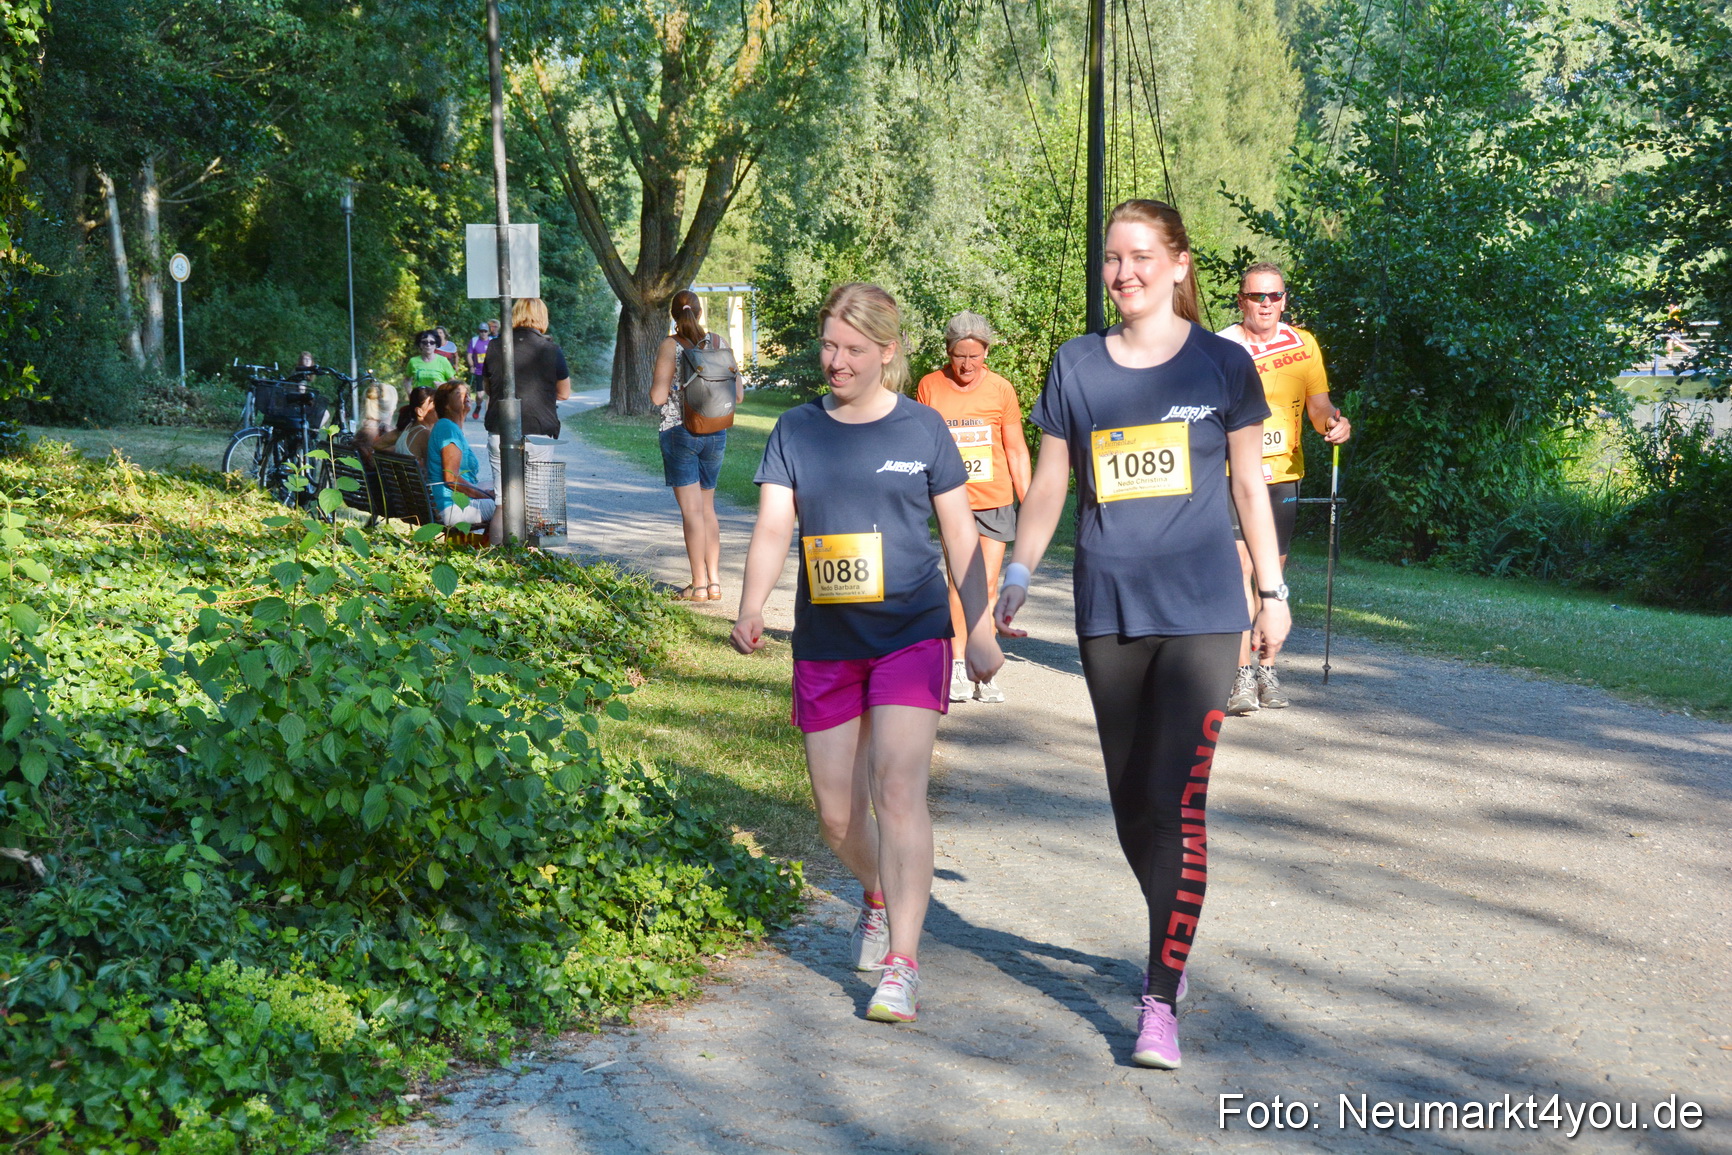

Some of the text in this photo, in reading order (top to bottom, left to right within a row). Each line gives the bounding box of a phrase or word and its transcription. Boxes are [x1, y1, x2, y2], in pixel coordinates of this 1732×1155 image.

[1272, 350, 1311, 369] BÖGL
[946, 419, 959, 427] 30
[1263, 430, 1282, 446] 30
[963, 459, 982, 473] 92
[1107, 449, 1175, 479] 1089
[1135, 477, 1168, 485] Christina
[814, 558, 870, 584] 1088
[1161, 709, 1226, 971] UNLIMITED
